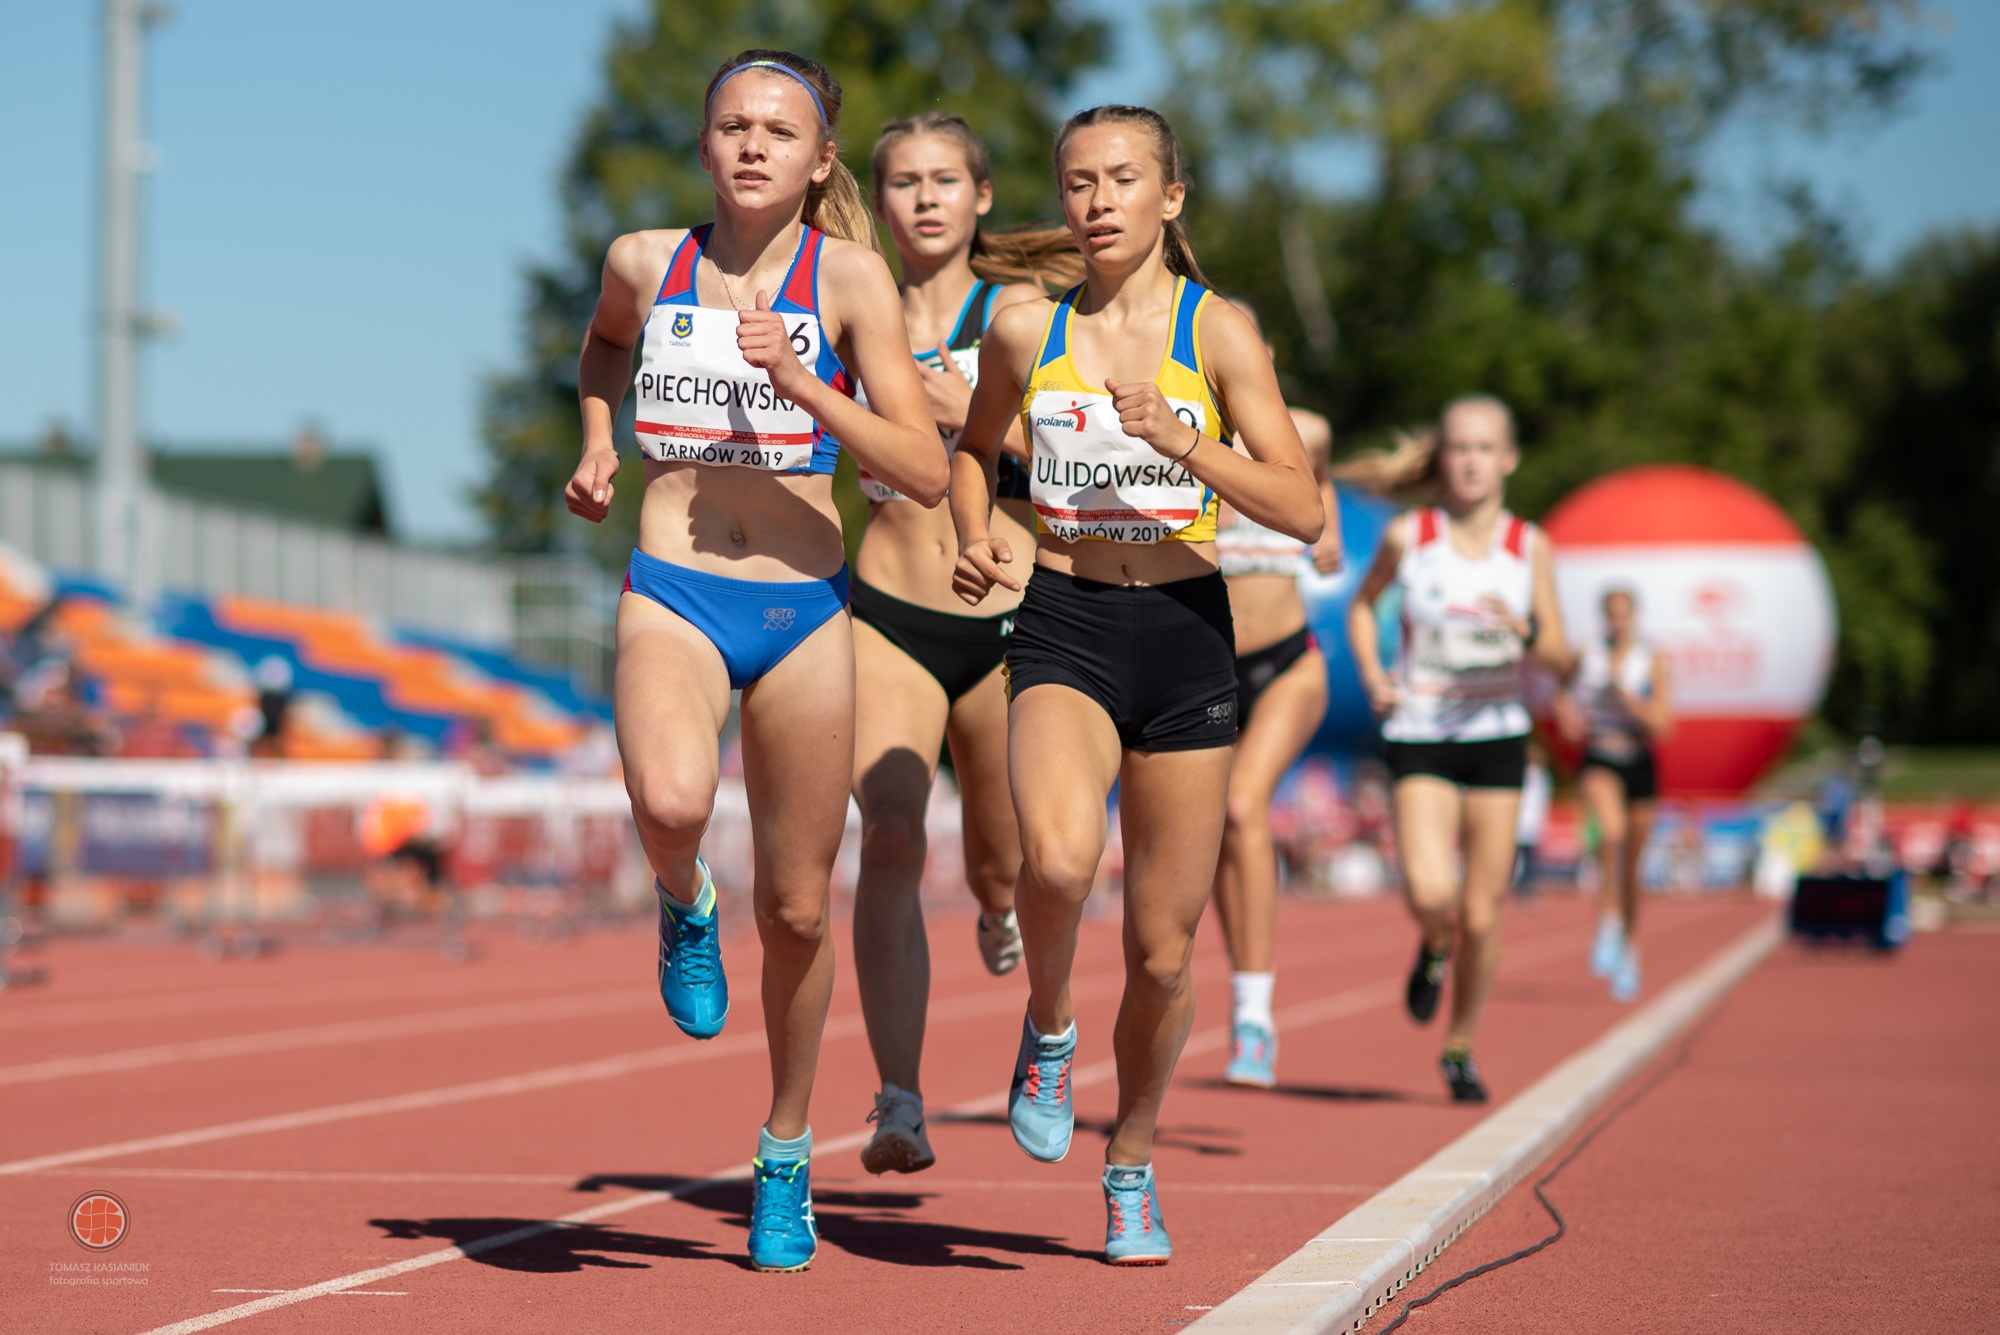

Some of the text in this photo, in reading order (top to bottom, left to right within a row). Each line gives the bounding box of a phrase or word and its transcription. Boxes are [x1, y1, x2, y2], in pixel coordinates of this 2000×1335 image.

[669, 340, 692, 348] TARNÓW
[642, 372, 795, 411] PIECHOWSK
[659, 442, 783, 467] TARNÓW 2019
[1037, 457, 1196, 490] ULIDOWSKA
